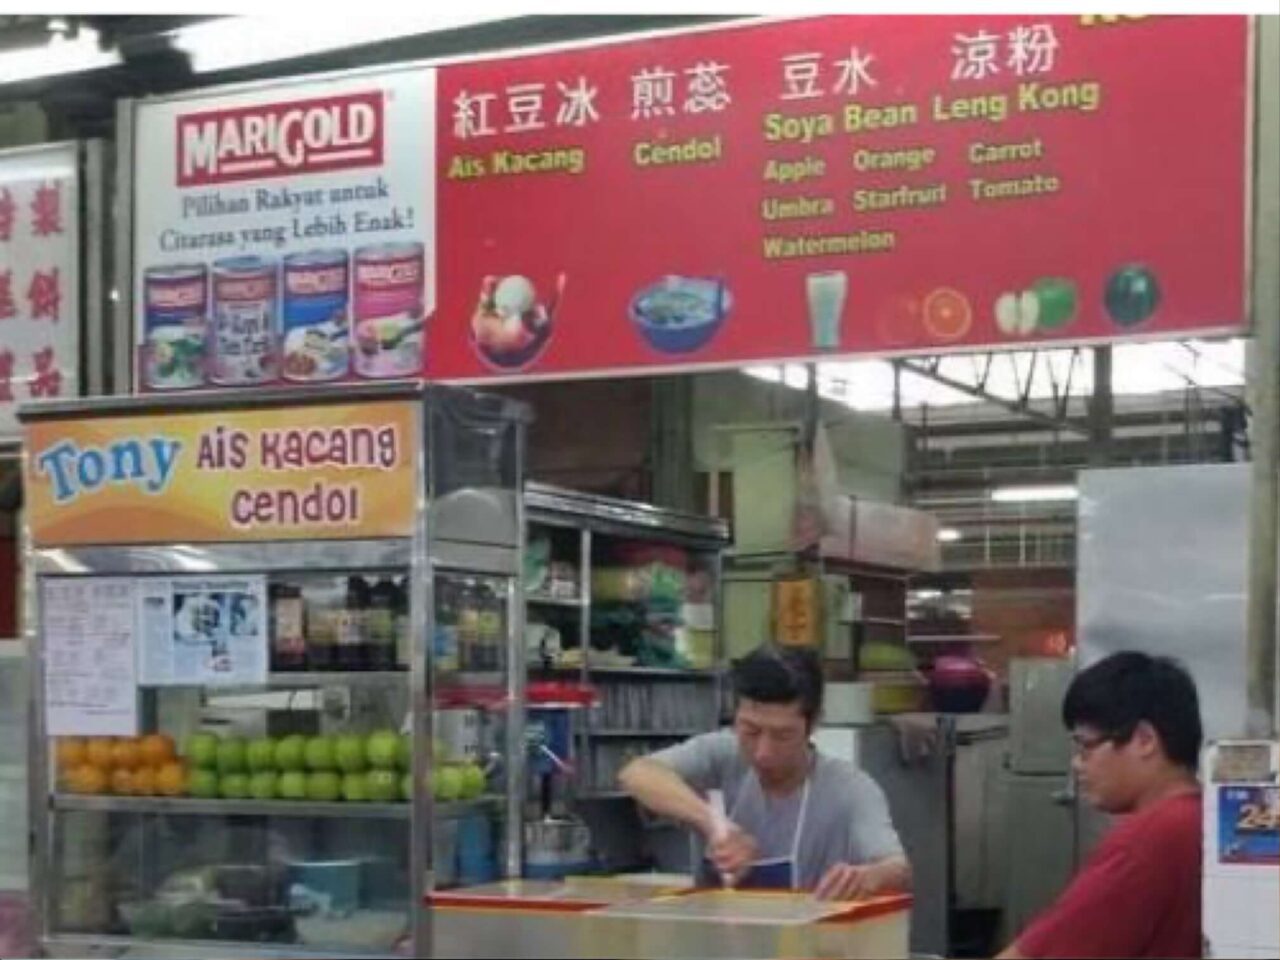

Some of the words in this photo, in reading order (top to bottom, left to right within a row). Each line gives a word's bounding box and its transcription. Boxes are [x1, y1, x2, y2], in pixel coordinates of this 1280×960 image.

[951, 24, 1059, 80] 涼粉
[779, 46, 879, 100] 豆水
[452, 76, 600, 140] 紅豆冰
[933, 95, 1007, 121] Leng
[1018, 81, 1100, 109] Kong
[764, 113, 833, 143] Soya
[843, 102, 918, 131] Bean
[182, 103, 376, 177] MARIGOLD
[634, 137, 721, 166] Cendol
[969, 139, 1042, 163] Carrot
[448, 154, 486, 178] Ais
[493, 148, 584, 174] Kacang
[764, 157, 826, 183] Apple
[853, 148, 936, 171] Orange
[969, 175, 1059, 199] Tomato
[182, 190, 249, 218] Pilihan
[761, 197, 834, 220] Umbra
[240, 225, 286, 249] yang
[292, 215, 347, 239] Lebih
[354, 206, 414, 232] Enak!
[763, 231, 895, 258] Watermelon
[39, 438, 182, 500] Tony
